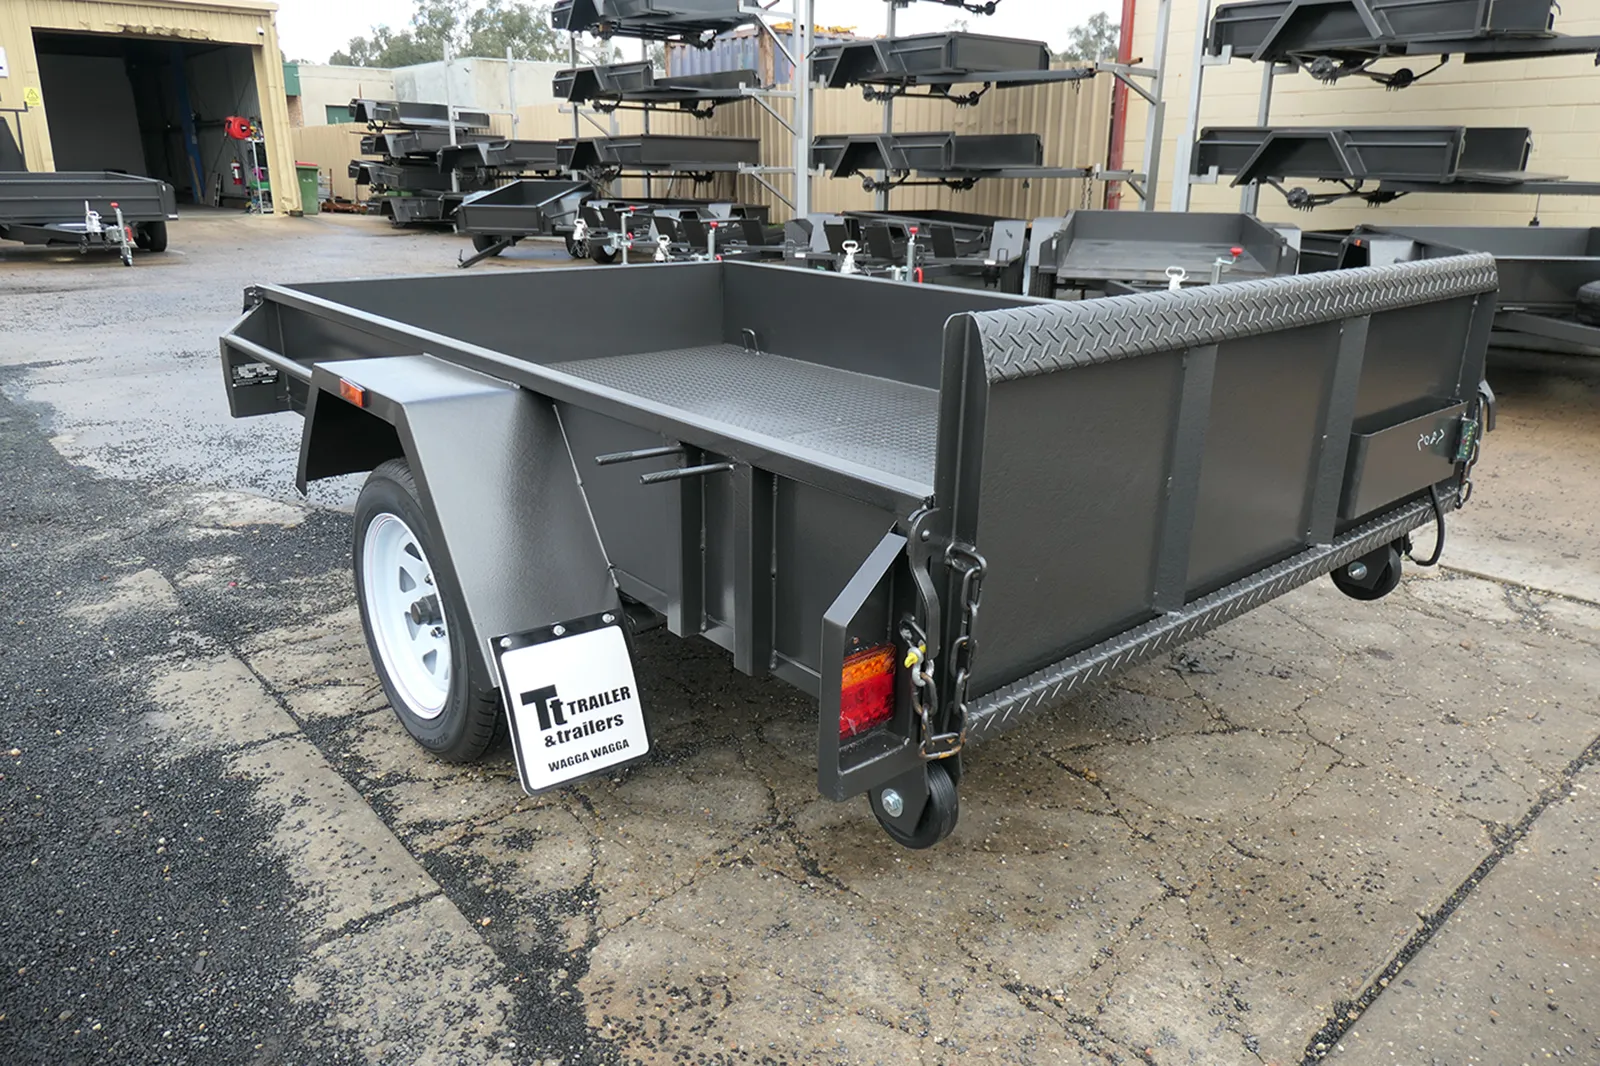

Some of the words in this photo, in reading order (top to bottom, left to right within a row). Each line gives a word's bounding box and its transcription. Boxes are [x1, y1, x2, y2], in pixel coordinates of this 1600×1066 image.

[566, 686, 631, 716] TRAILER
[544, 735, 556, 748] &
[556, 714, 624, 744] trailers
[548, 752, 590, 772] WAGGA
[590, 739, 630, 758] WAGGA
